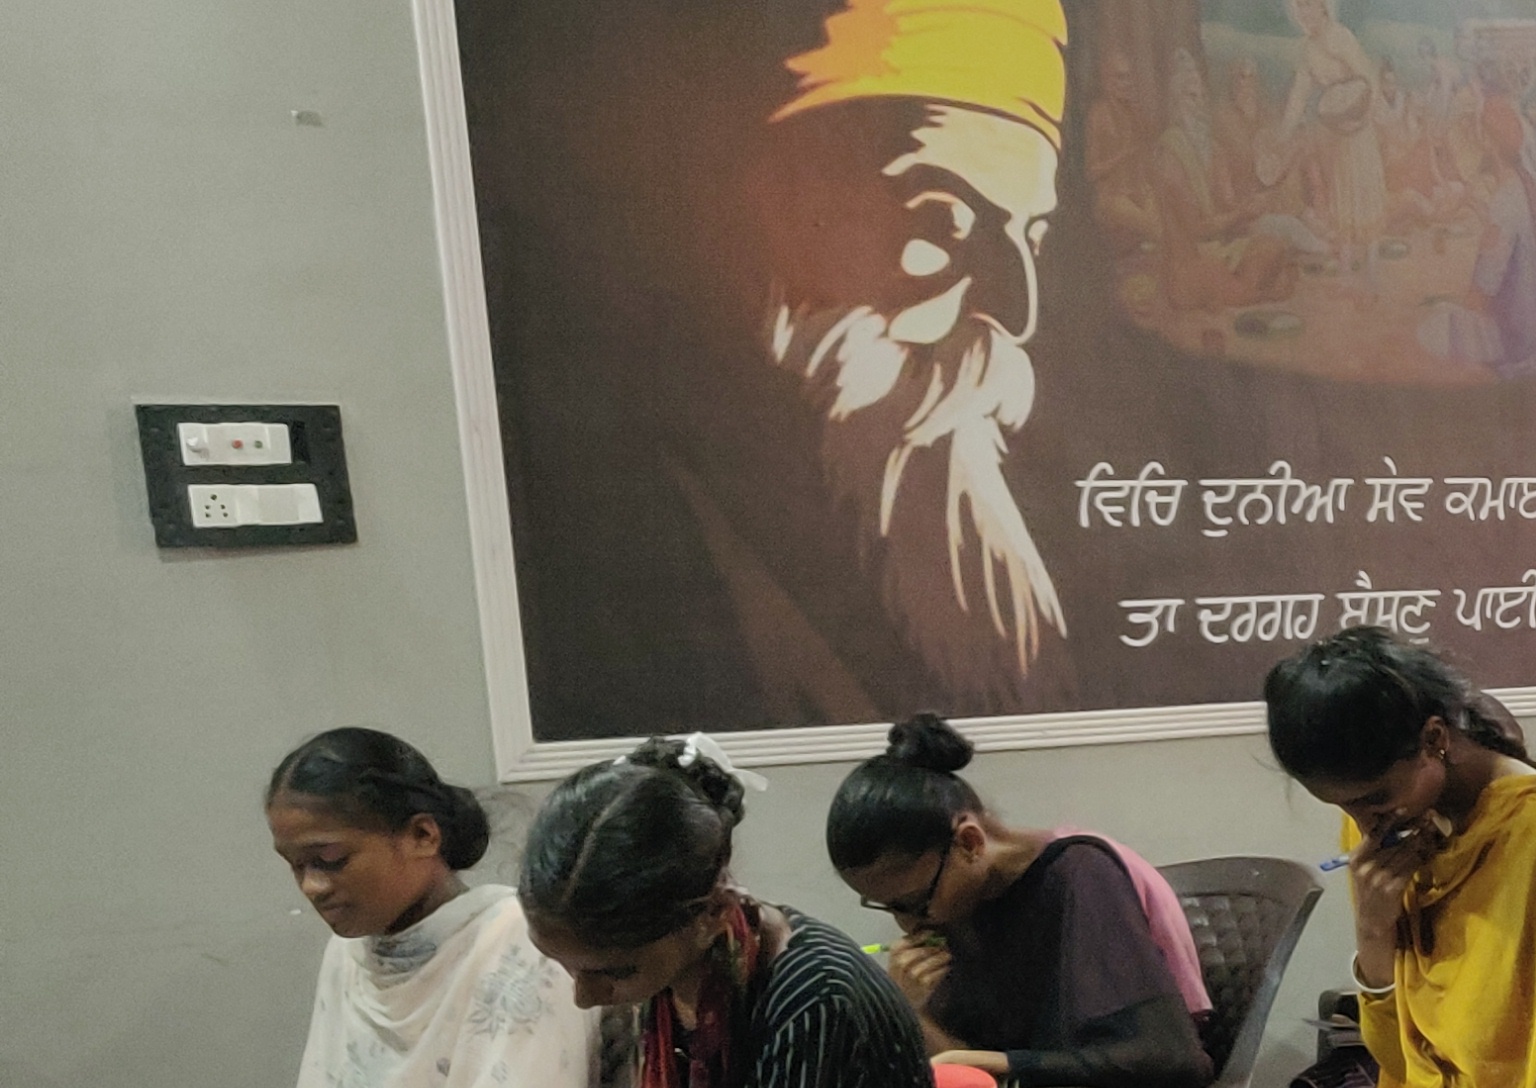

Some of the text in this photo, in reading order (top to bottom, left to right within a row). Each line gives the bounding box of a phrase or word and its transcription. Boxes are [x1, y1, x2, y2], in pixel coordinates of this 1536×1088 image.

[1073, 461, 1189, 528] ਵਿਚਿ
[1198, 460, 1355, 538] ਦੁਨੀਆ
[1364, 455, 1434, 522] ਸੇਵ
[1117, 598, 1186, 648] ਤਾ
[1194, 592, 1326, 643] ਦਰਗਹ
